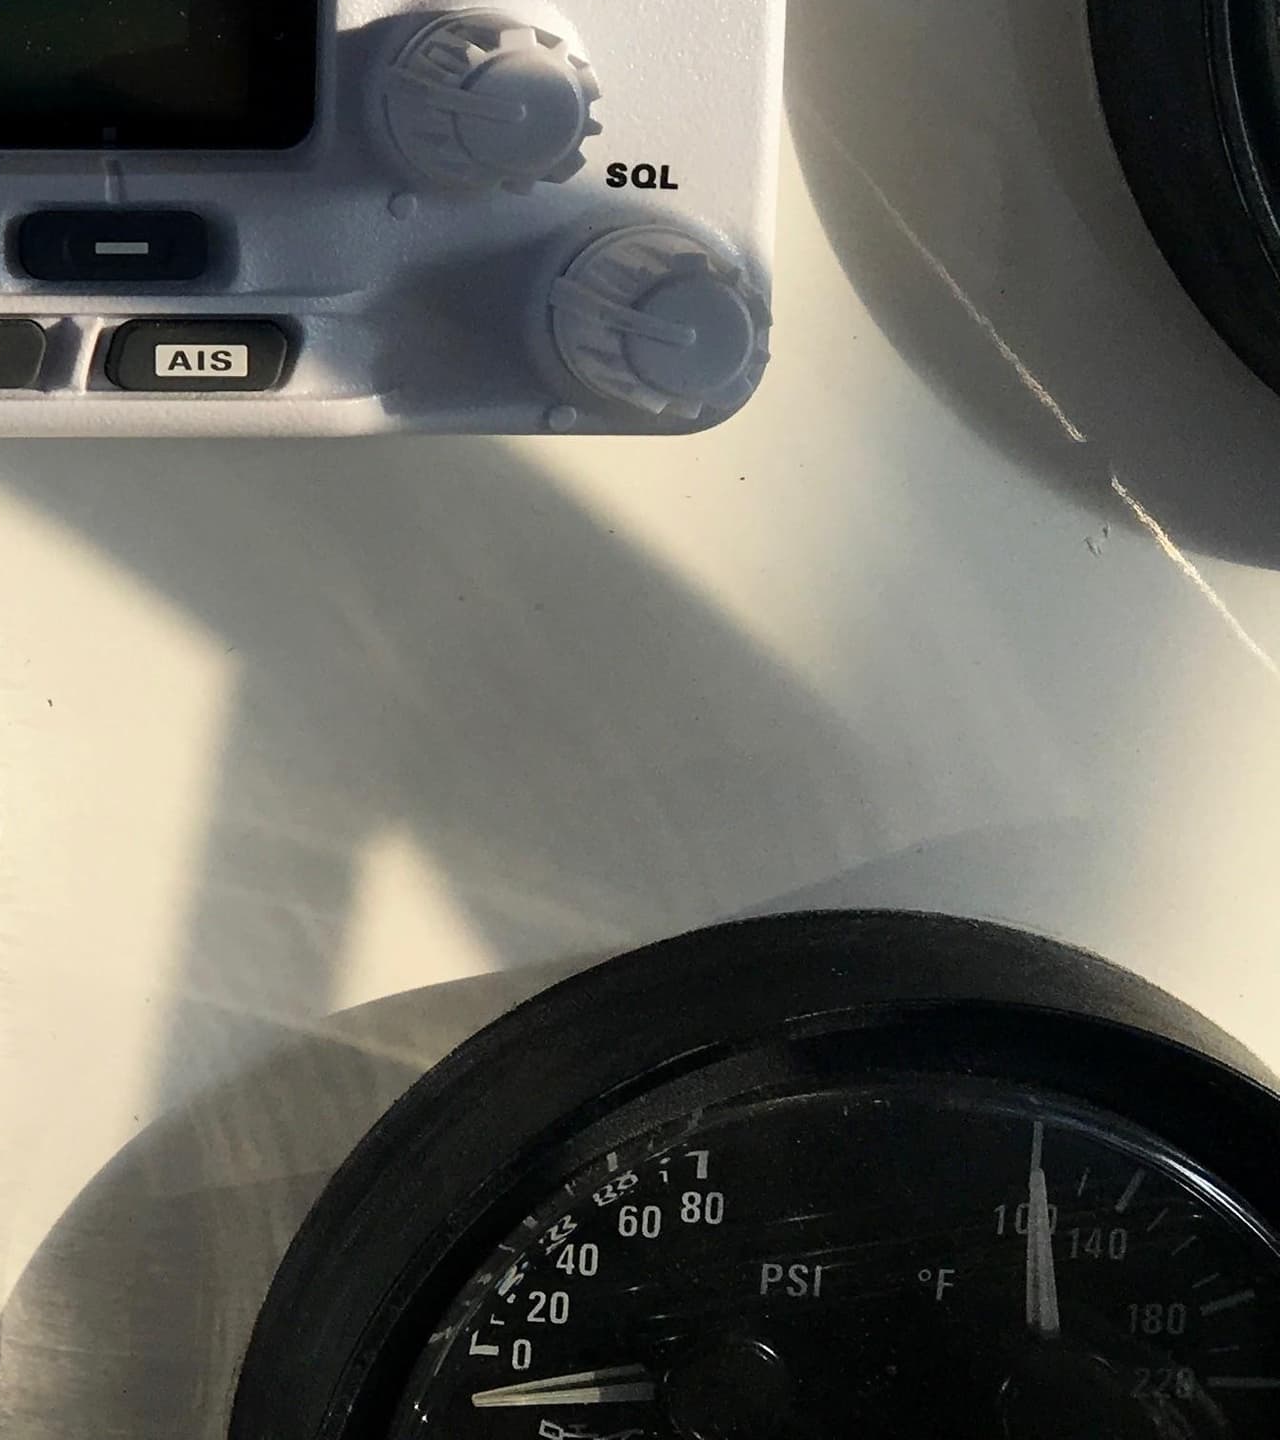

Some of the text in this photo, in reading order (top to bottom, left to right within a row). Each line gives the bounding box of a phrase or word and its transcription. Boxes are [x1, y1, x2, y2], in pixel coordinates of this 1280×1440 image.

[606, 162, 679, 190] SQL
[167, 350, 234, 372] AIS
[618, 1205, 662, 1239] 60
[680, 1191, 725, 1225] 80
[556, 1243, 599, 1277] 40
[1070, 1227, 1129, 1260] 140
[759, 1263, 823, 1297] PSI
[526, 1290, 570, 1325] 20
[1128, 1303, 1187, 1335] 180
[511, 1338, 533, 1370] 0
